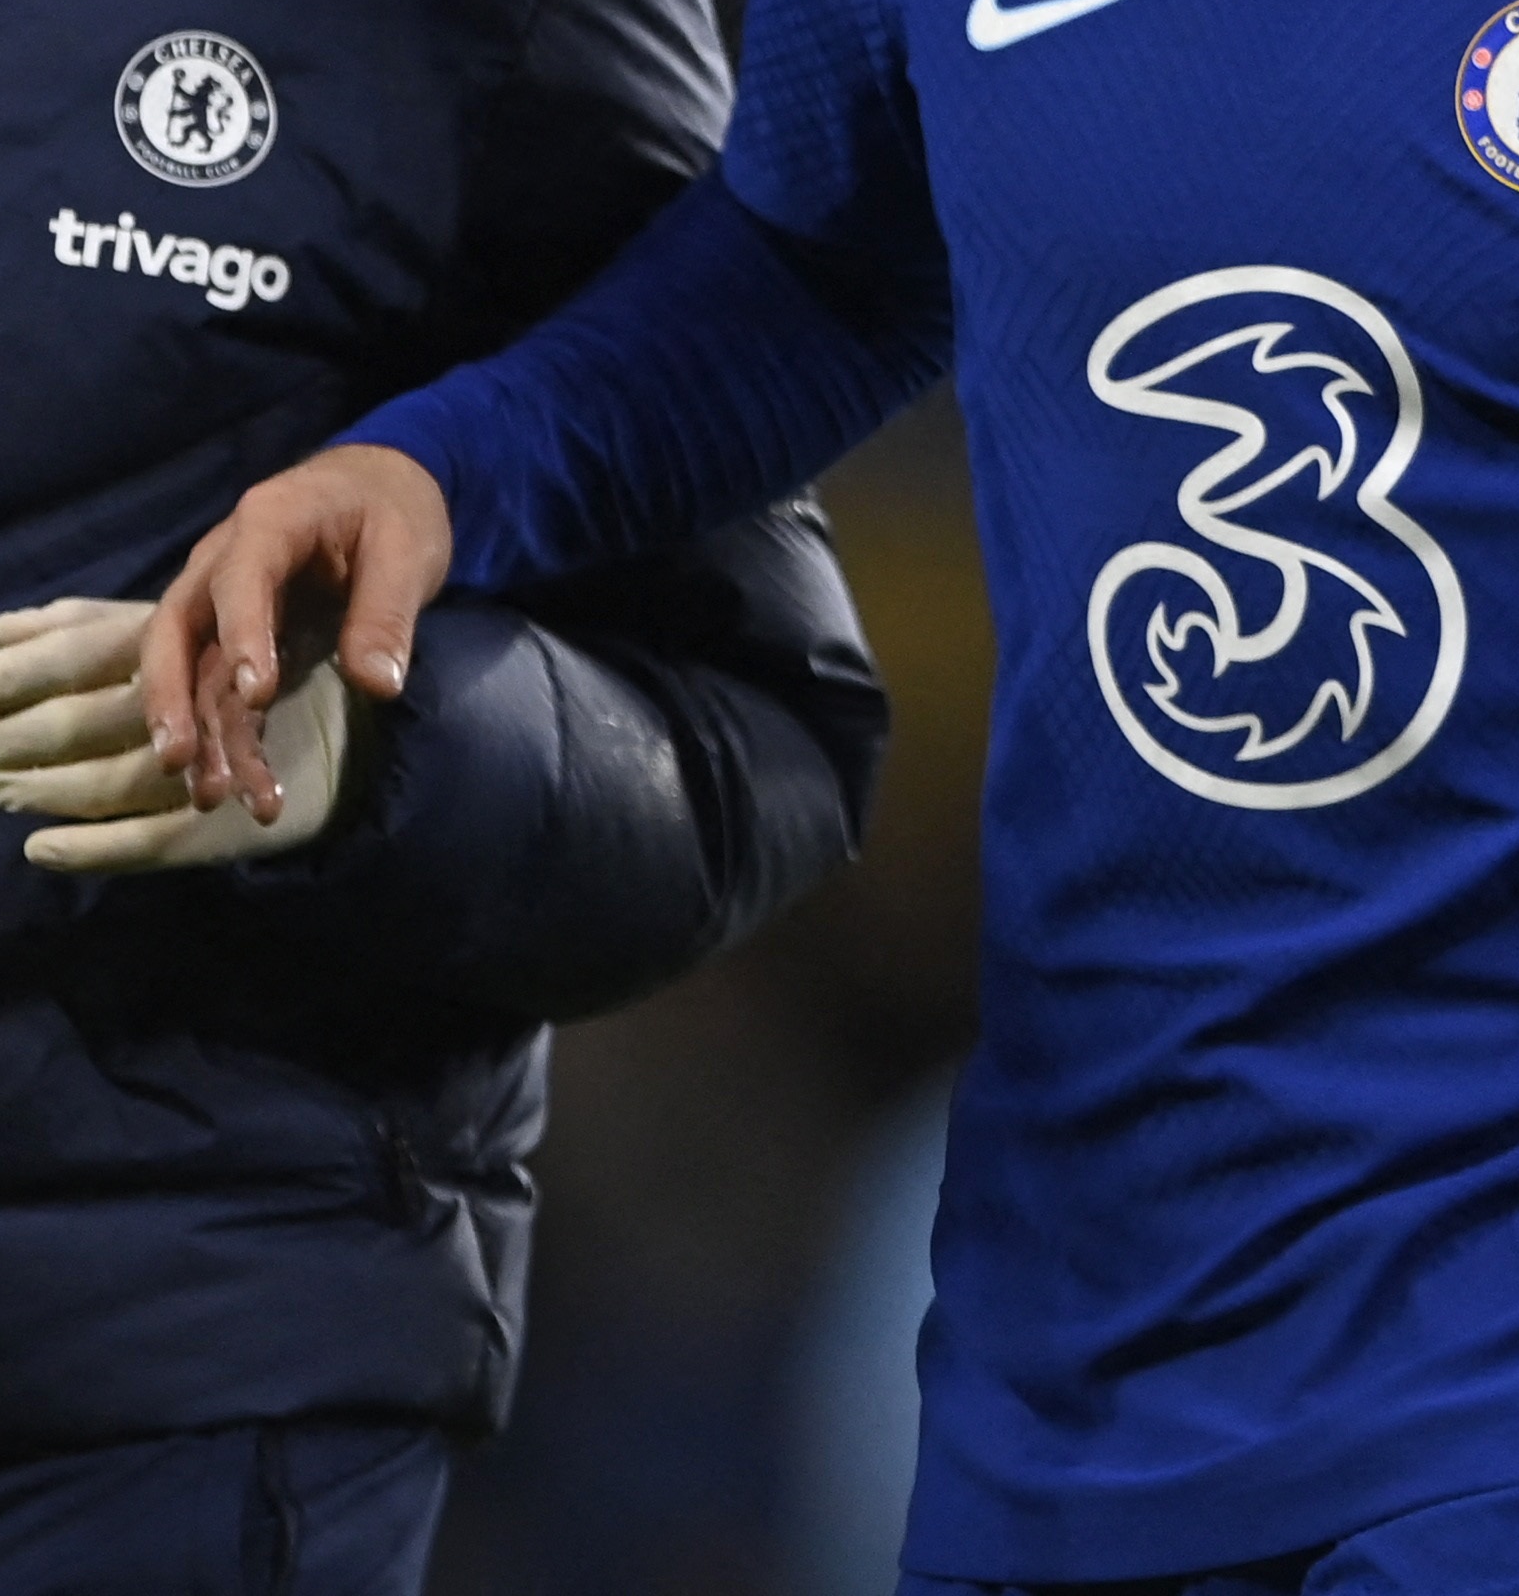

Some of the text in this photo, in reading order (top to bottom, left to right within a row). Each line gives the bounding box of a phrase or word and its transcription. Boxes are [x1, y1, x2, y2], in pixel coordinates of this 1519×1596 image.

[154, 38, 254, 84] CHELSEA
[135, 138, 240, 179] FOOTBALL CLUB
[48, 207, 292, 311] trivago
[1087, 265, 1467, 810] 3
